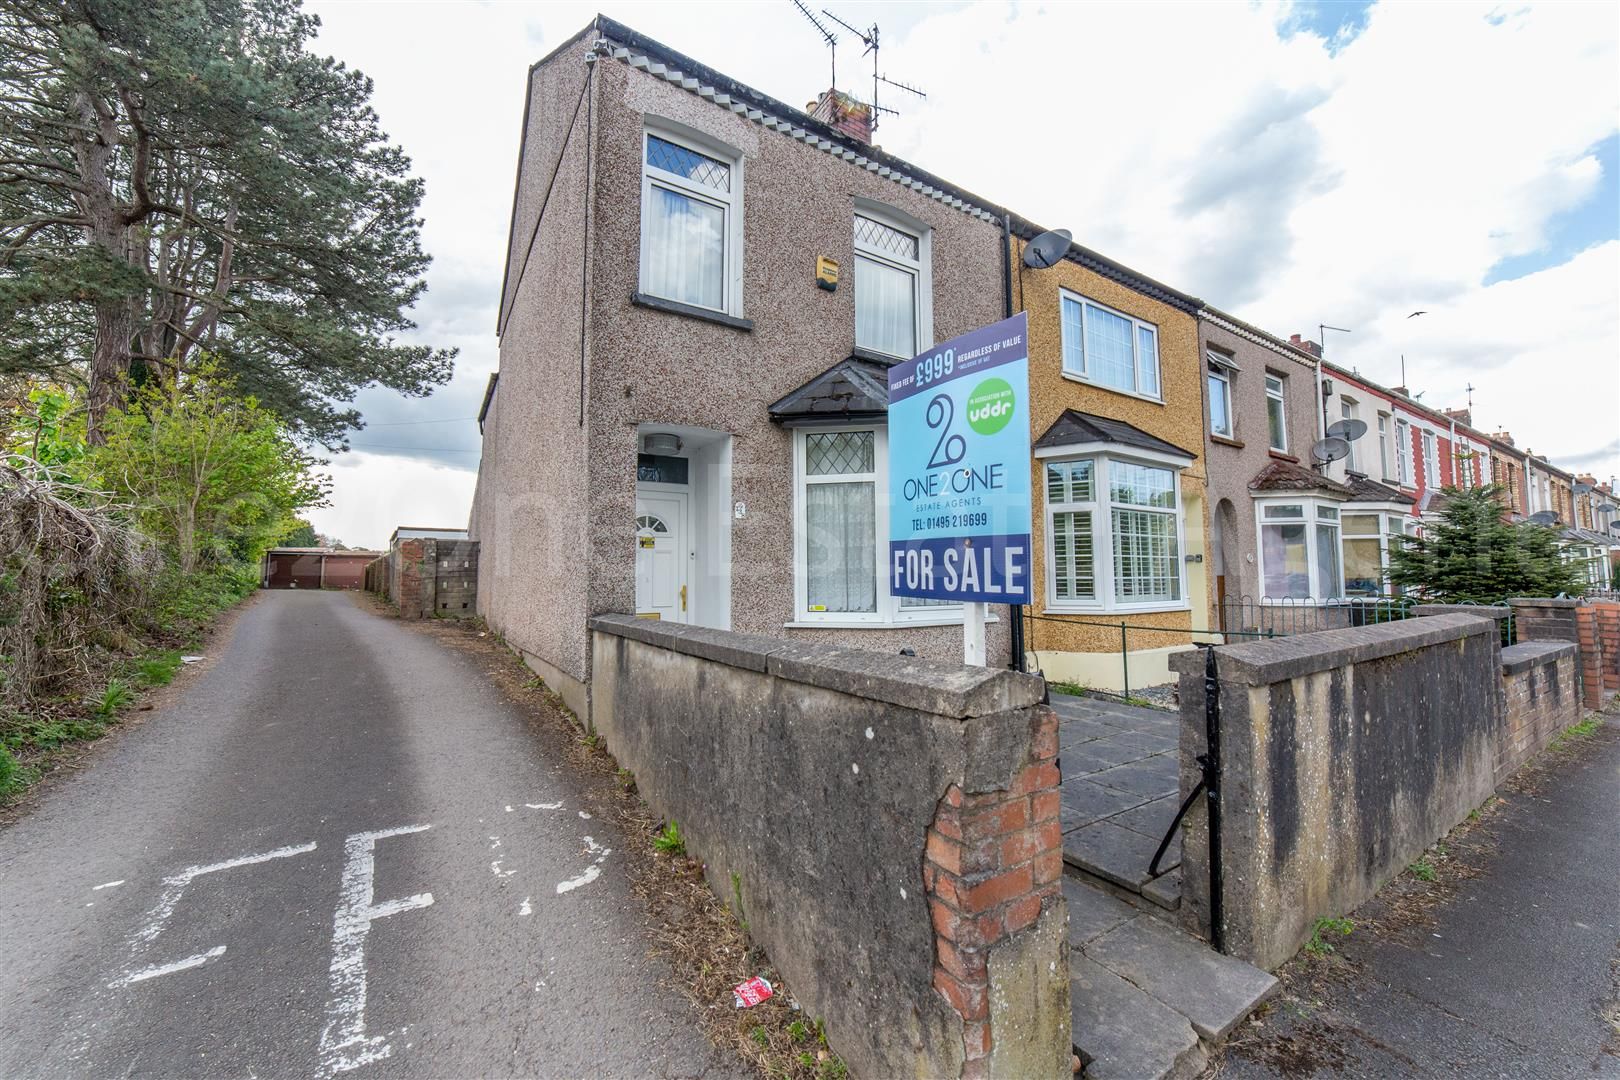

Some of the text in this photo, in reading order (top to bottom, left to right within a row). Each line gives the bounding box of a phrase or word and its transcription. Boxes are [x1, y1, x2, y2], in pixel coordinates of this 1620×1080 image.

[957, 345, 992, 363] REGARDLESS
[993, 342, 1001, 352] OF
[1002, 335, 1022, 348] VALUE
[903, 463, 1003, 501] ONE2ONE
[916, 497, 982, 513] ESTATE AGENTS
[912, 512, 987, 531] TEL: 01495 219699
[894, 546, 1024, 594] FOR SALE
